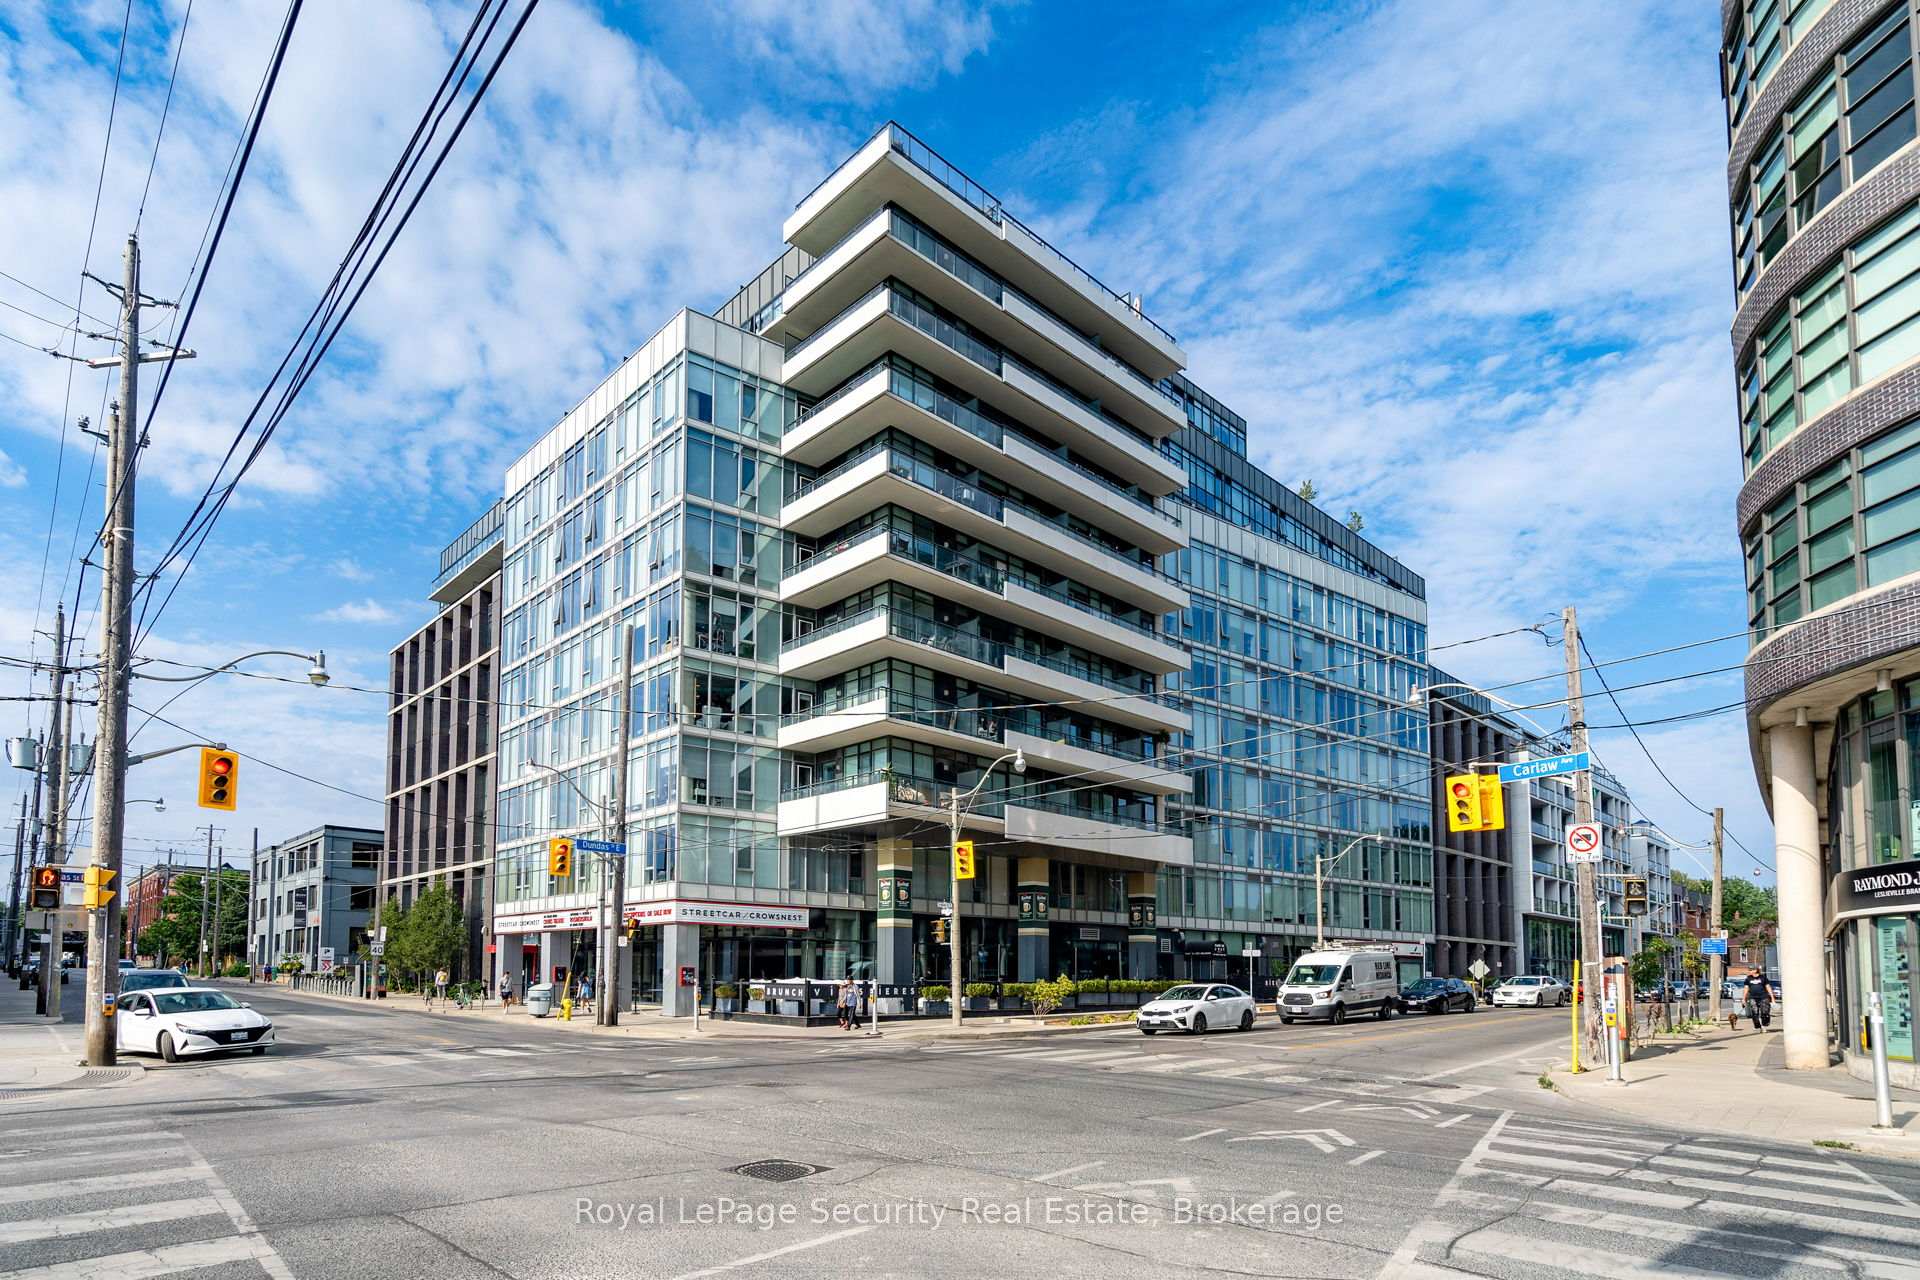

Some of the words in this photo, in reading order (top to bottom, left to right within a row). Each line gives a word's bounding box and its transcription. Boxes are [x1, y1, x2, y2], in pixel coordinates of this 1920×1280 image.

[1513, 760, 1558, 776] Carlaw
[582, 840, 609, 850] Dundas
[1853, 872, 1912, 892] RAYMOND
[1874, 889, 1905, 898] LESLIEVILLE
[372, 946, 383, 954] 40
[766, 986, 803, 997] BRUNCH
